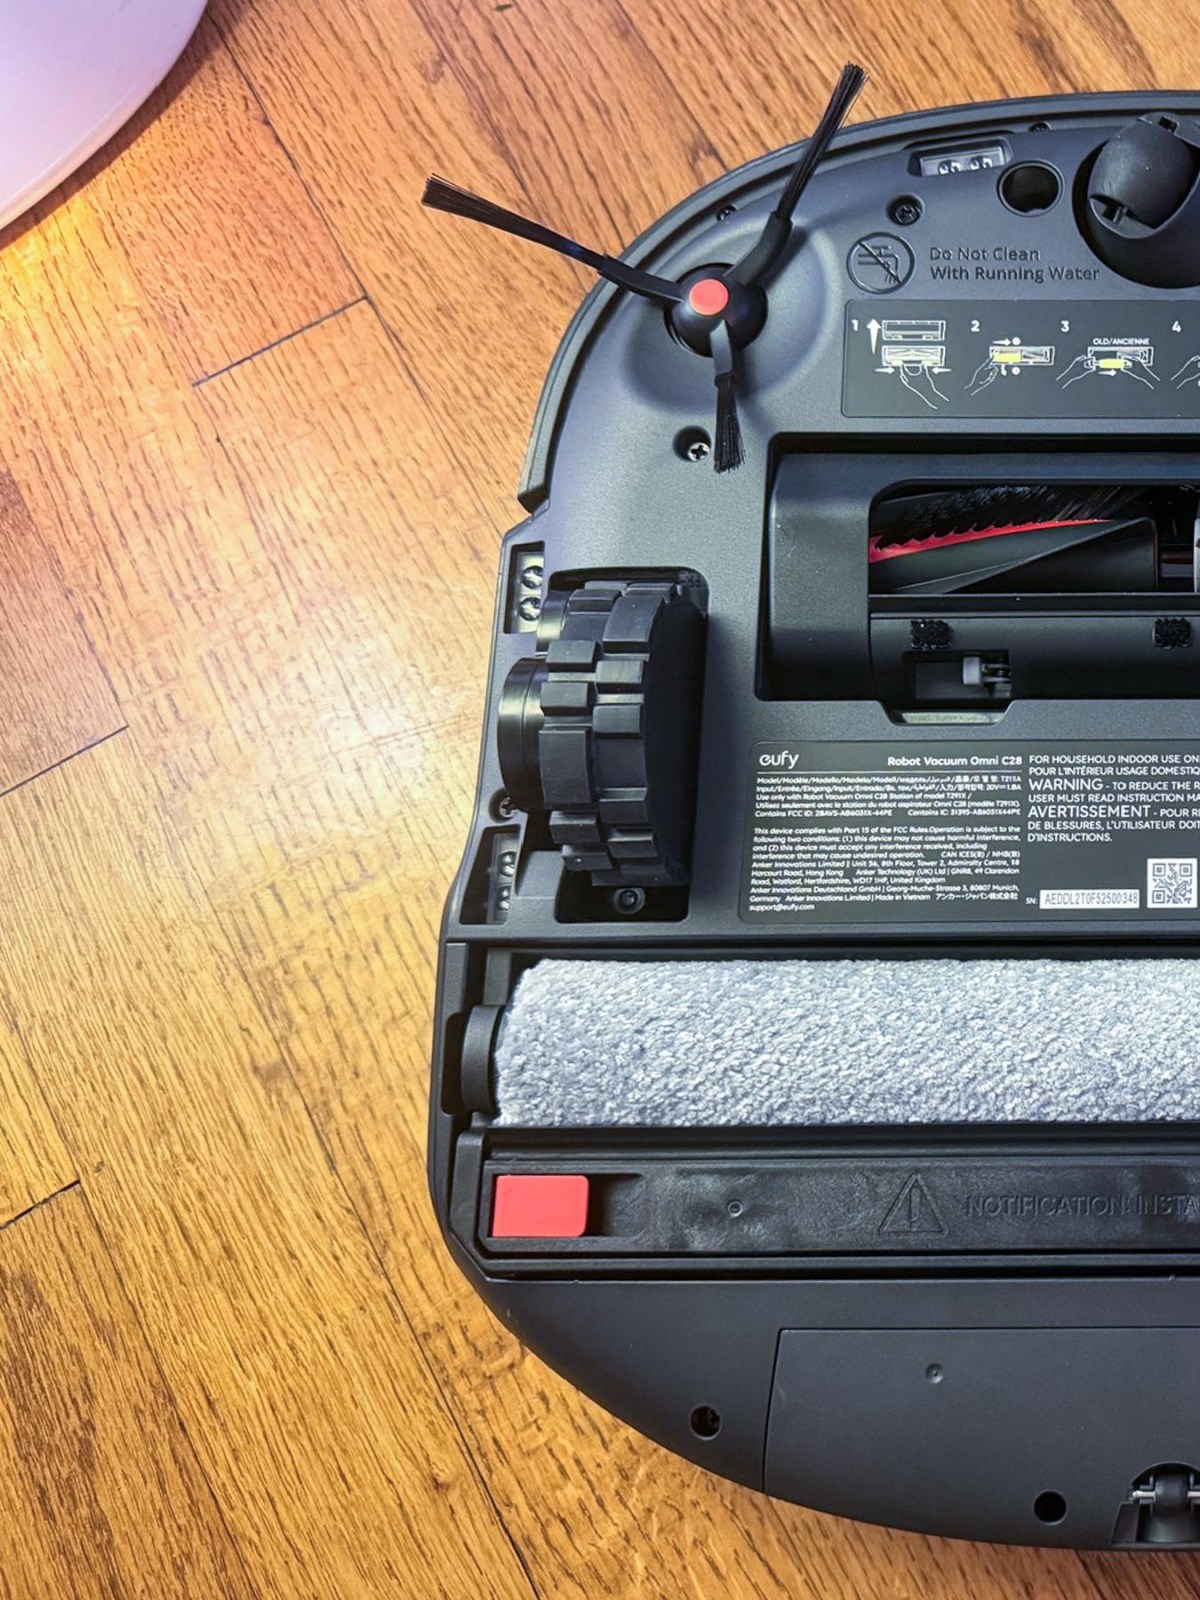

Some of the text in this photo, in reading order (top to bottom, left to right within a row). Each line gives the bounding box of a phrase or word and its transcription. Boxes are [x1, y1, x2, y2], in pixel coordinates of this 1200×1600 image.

[930, 247, 1040, 260] Do Not Clean
[930, 267, 1100, 283] With Running Water
[851, 319, 858, 331] 1
[971, 320, 980, 332] 2
[1061, 320, 1070, 332] 3
[1172, 320, 1182, 332] 4
[1092, 337, 1150, 346] OLD/ANCIENNE
[759, 750, 799, 769] eufy
[887, 756, 1023, 766] Robot Vacuum Omni C28
[1029, 755, 1050, 763] FOR
[1052, 755, 1116, 763] HOUSEHOLD
[1118, 755, 1158, 763] INDOOR
[1161, 754, 1180, 763] USE
[1028, 767, 1056, 775] POUR
[1058, 765, 1114, 775] L'INTÉRIEUR
[1116, 766, 1148, 775] USAGE
[1028, 779, 1103, 790] WARNING
[1112, 781, 1127, 790] TO
[1129, 781, 1168, 790] REDUCE
[1172, 781, 1191, 790] THE
[1028, 794, 1055, 802] USER
[1057, 794, 1085, 802] MUST
[1088, 793, 1115, 802] READ
[1117, 793, 1184, 802] INSTRUCTION
[1027, 805, 1151, 817] AVERTISSEMENT
[1160, 808, 1189, 817] POUR
[1027, 821, 1041, 830] DE
[1044, 820, 1104, 831] BLESSURES,
[1106, 820, 1175, 830] L'UTILISATEUR
[1179, 820, 1200, 829] DOIT
[1027, 832, 1113, 842] D'INSTRUCTIONS.
[748, 904, 816, 912] support@eufy.com
